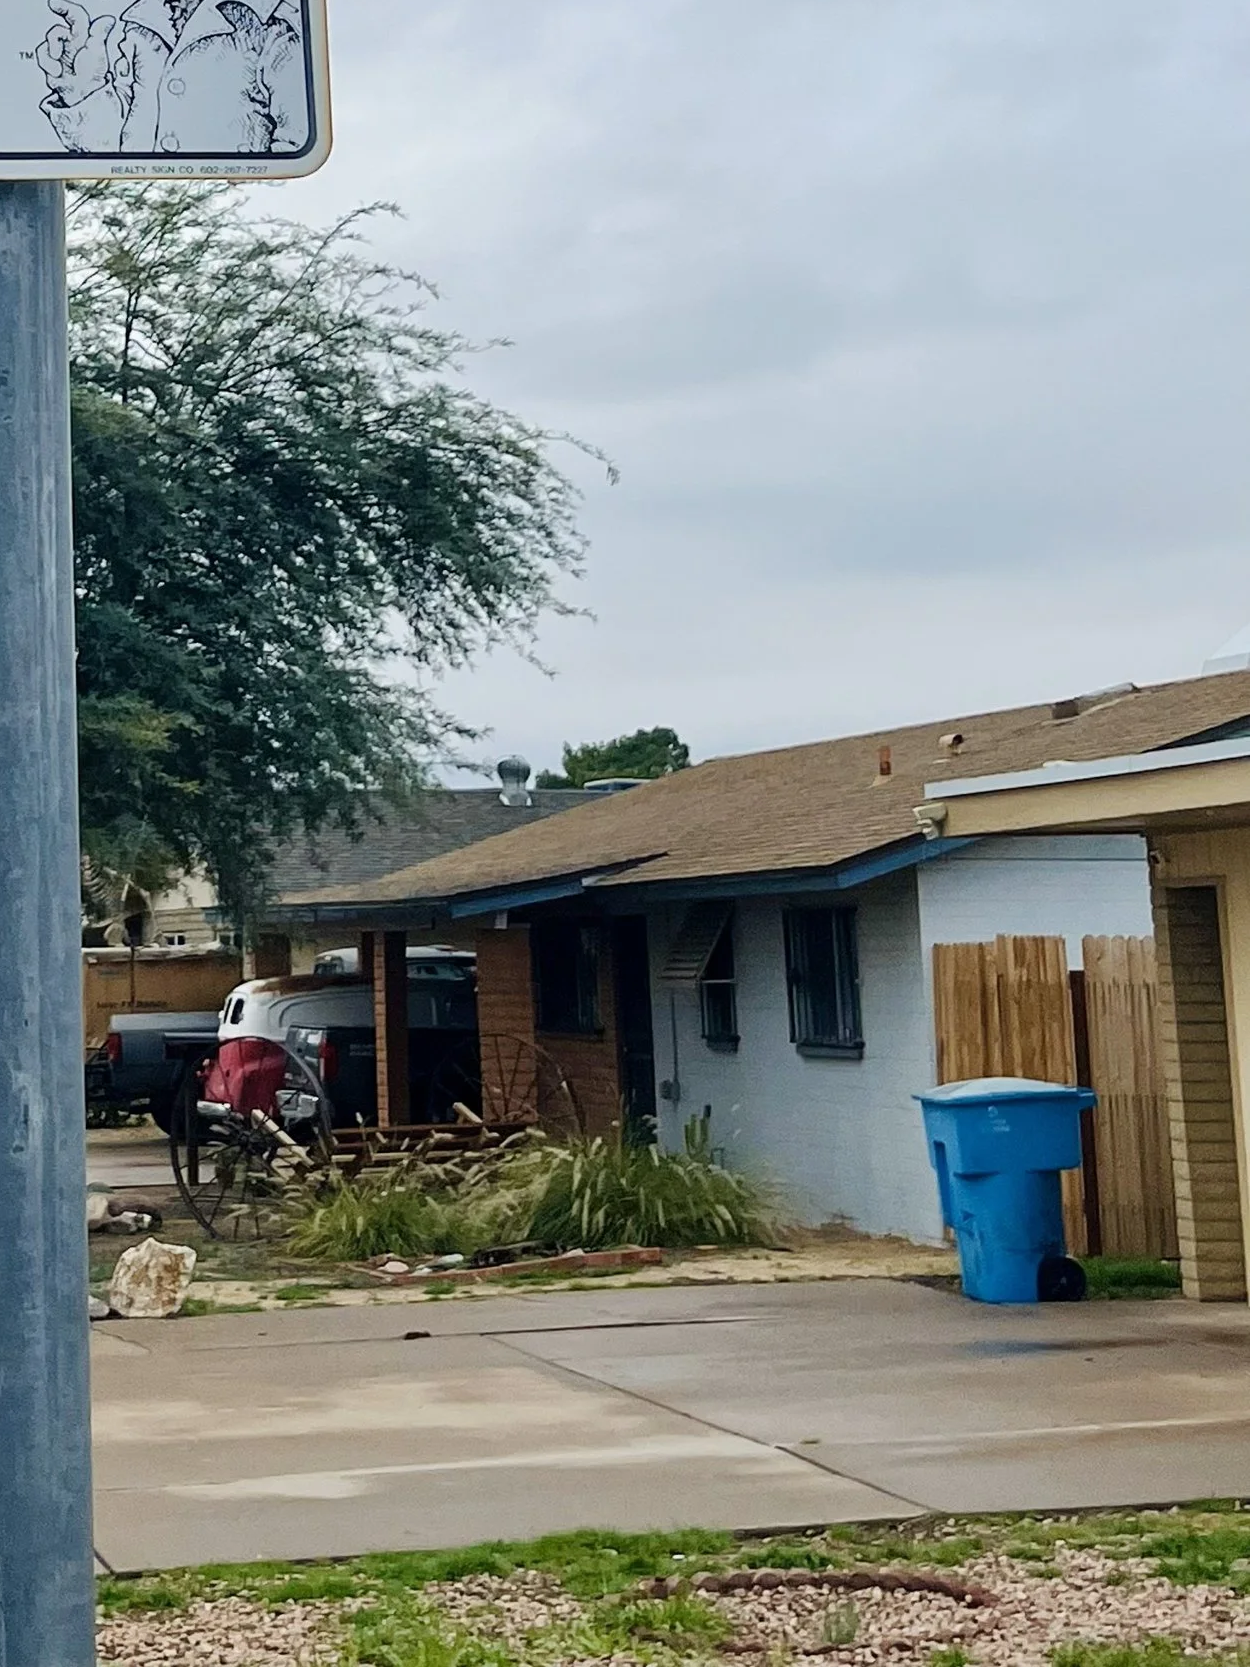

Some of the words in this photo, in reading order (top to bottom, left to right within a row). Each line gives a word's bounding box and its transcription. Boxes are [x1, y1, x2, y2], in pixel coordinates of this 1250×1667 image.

[19, 51, 34, 60] TM
[110, 165, 147, 174] REALTY
[152, 165, 175, 174] SIGN
